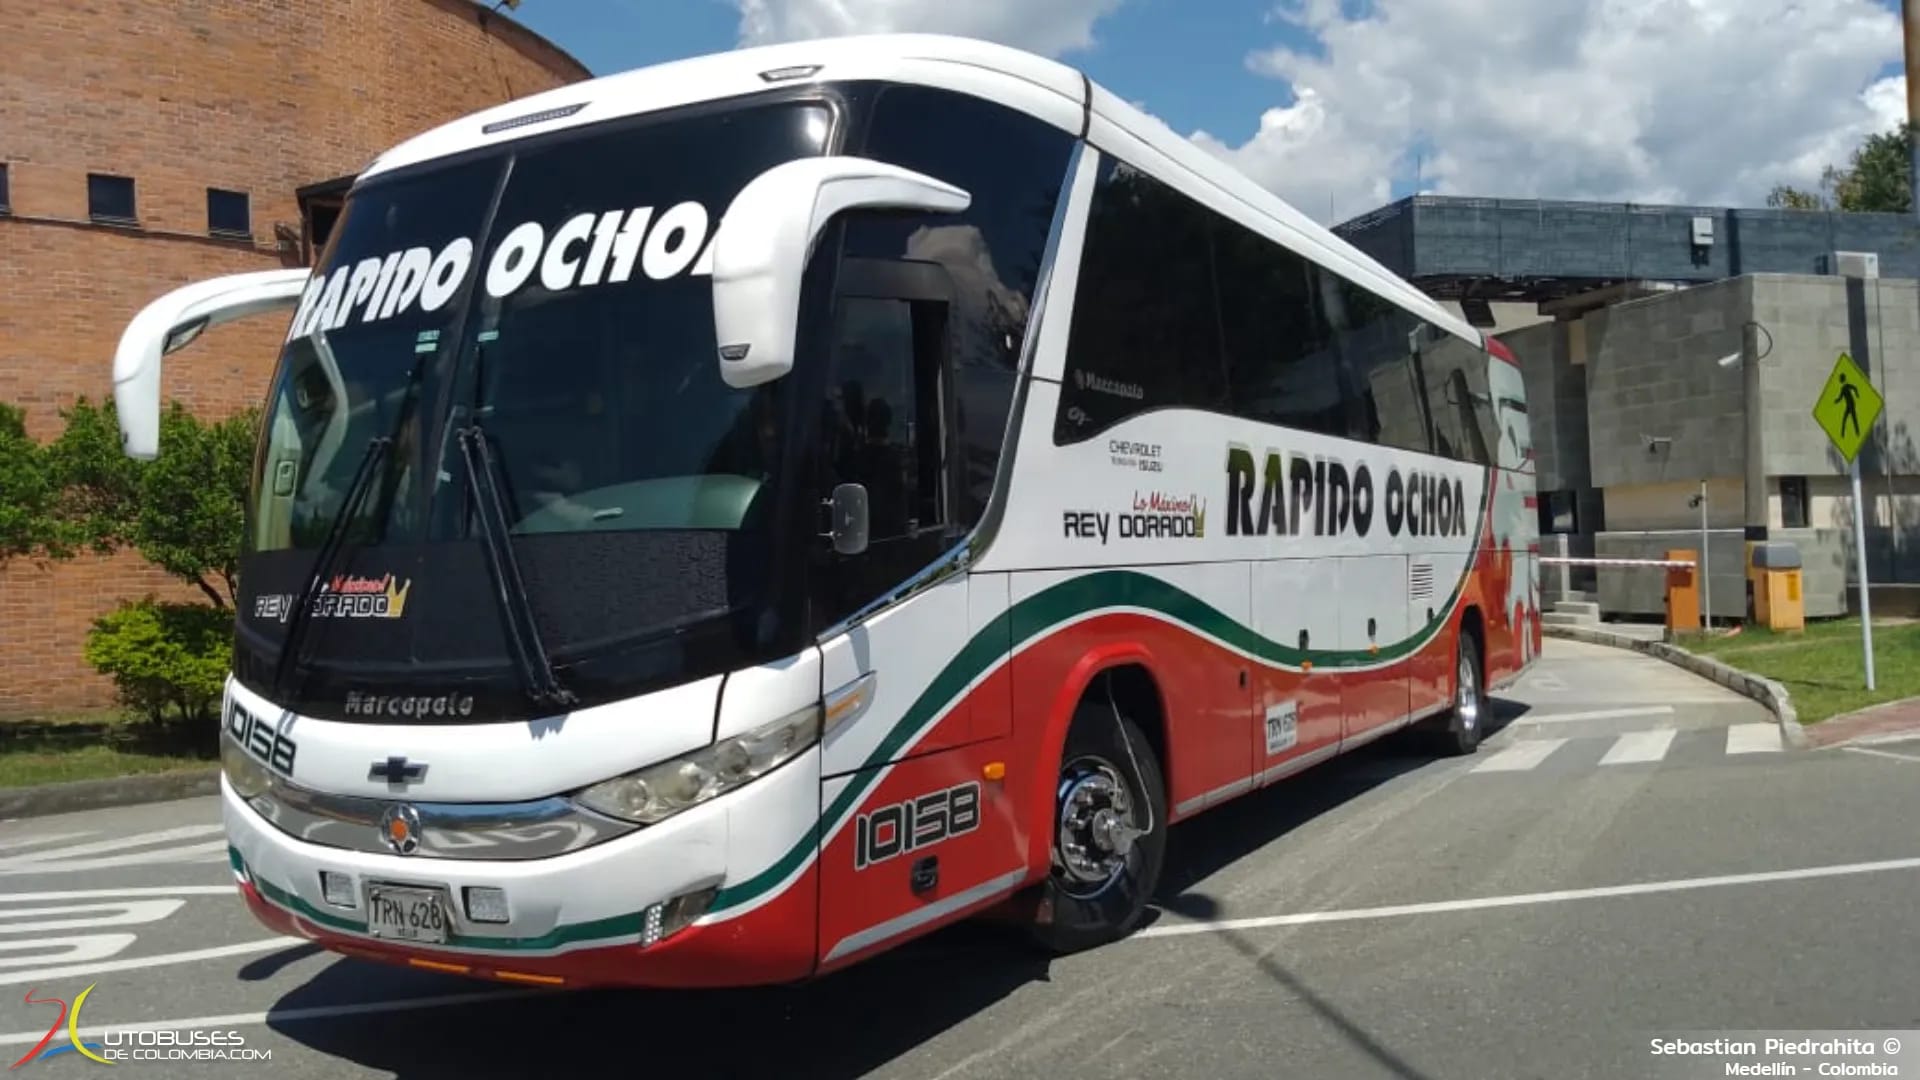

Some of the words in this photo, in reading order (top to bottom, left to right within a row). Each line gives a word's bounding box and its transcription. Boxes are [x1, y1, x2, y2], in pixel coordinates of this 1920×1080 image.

[286, 237, 473, 344] RAPIDO
[1109, 440, 1162, 457] CHEVROLET
[1225, 441, 1374, 538] RAPIDO
[1385, 461, 1467, 538] OCHOA
[1064, 512, 1110, 545] REY
[1119, 514, 1195, 538] DORADO
[344, 691, 473, 719] Marcopolo
[228, 697, 298, 778] 10158
[855, 781, 981, 872] 10158
[371, 895, 405, 926] TRN
[410, 901, 442, 930] 628
